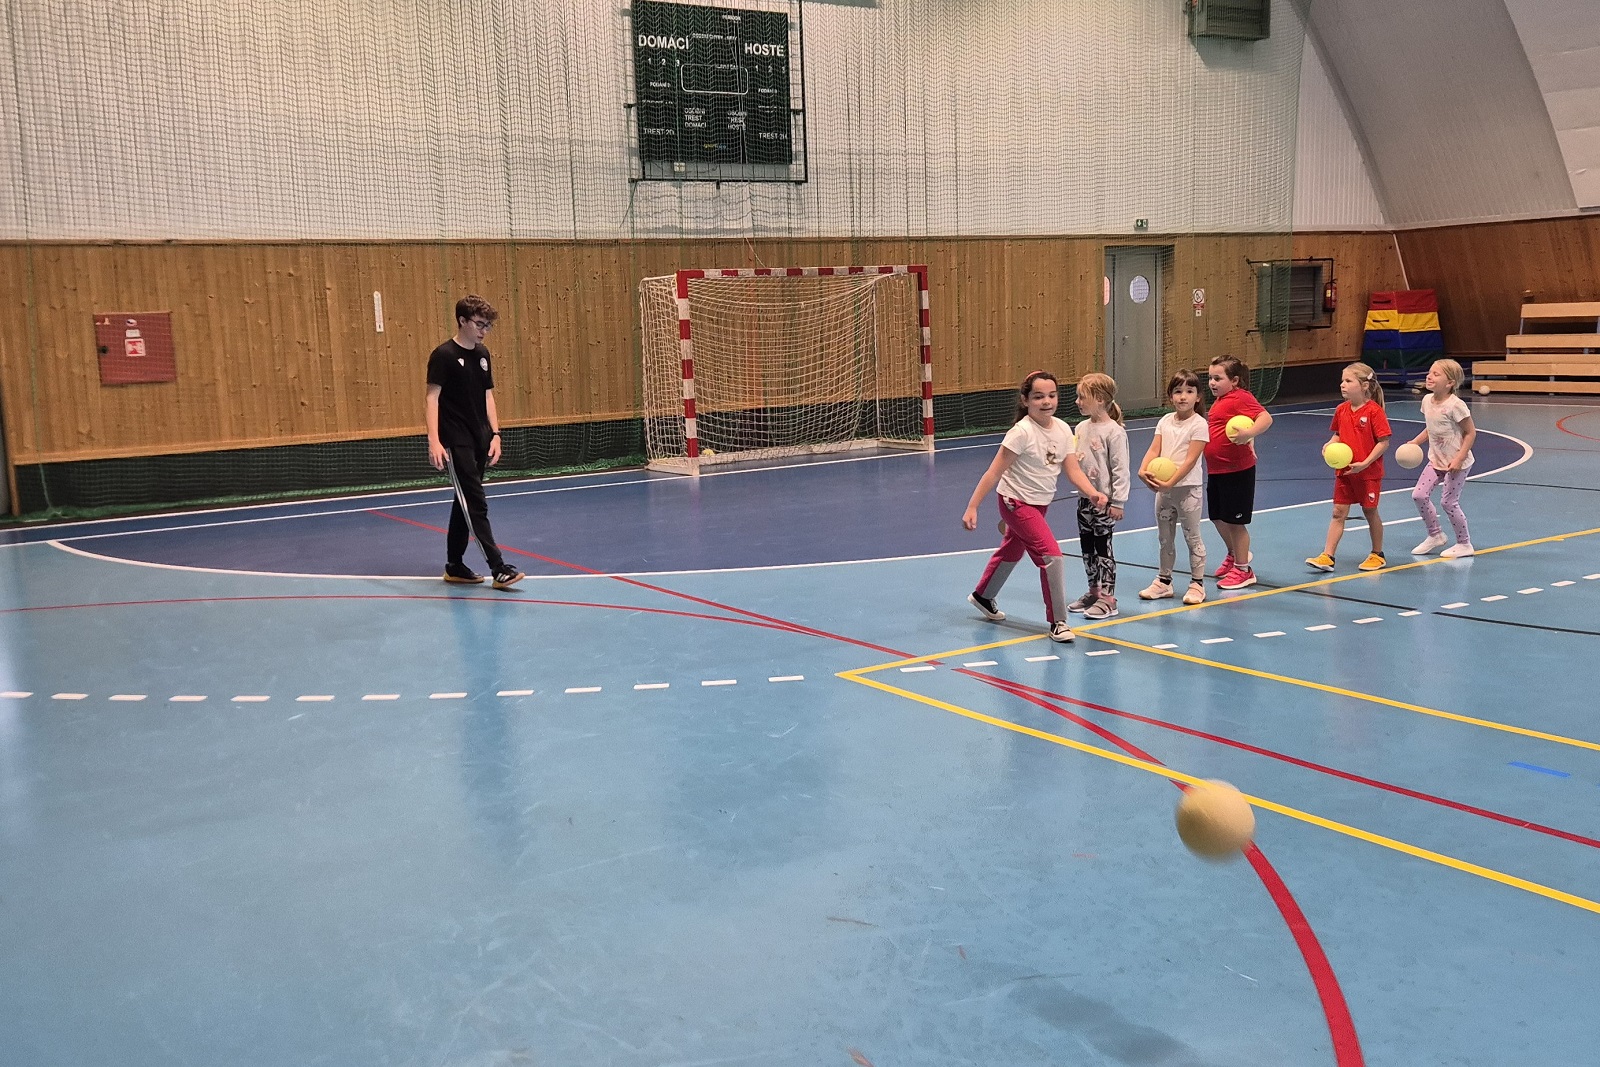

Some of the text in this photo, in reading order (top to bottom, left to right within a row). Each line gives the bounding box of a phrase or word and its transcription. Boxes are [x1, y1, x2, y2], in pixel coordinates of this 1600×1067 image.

[638, 34, 689, 50] DOMÁCÍ
[744, 42, 784, 57] HOSTÉ
[758, 132, 778, 140] TREST
